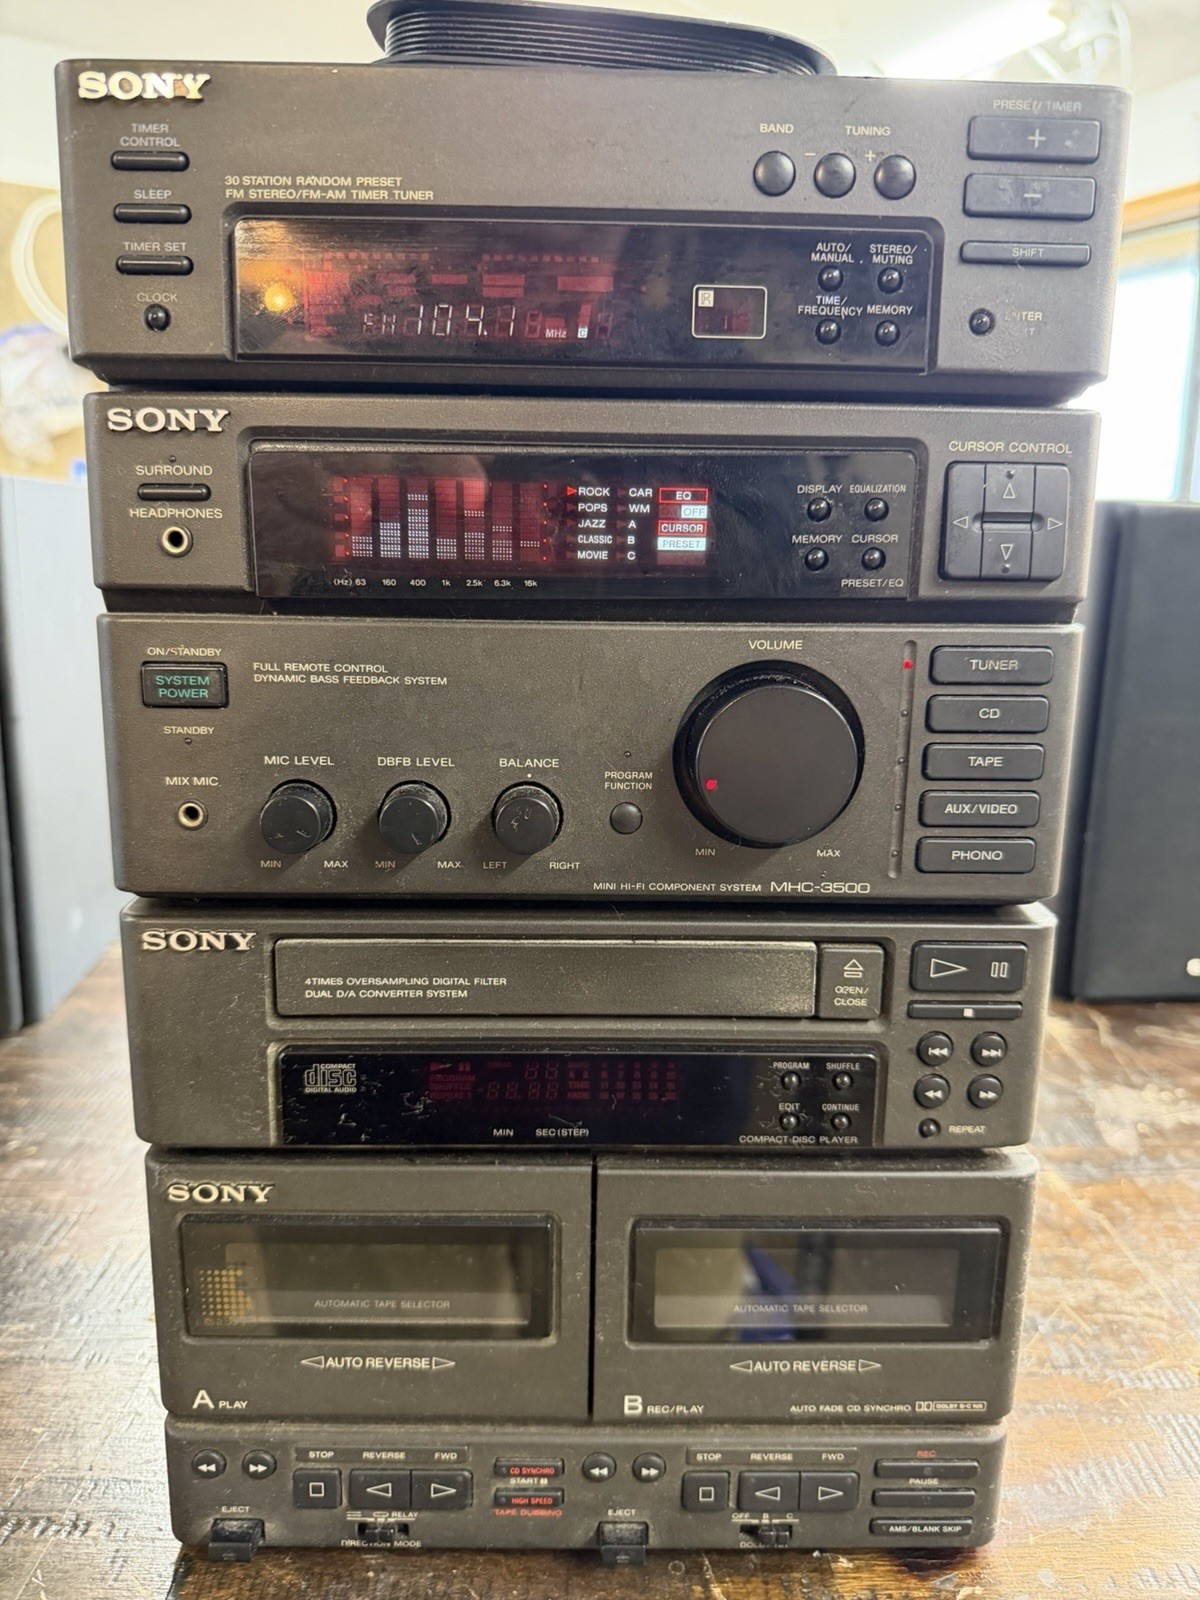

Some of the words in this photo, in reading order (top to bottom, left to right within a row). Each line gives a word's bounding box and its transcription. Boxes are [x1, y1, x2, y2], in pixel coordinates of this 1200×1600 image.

[78, 71, 211, 100] SONY
[131, 123, 169, 133] TIMER
[759, 123, 794, 134] BAND
[845, 126, 891, 137] TUNING
[120, 137, 180, 147] CONTROL
[224, 175, 240, 186] 30
[242, 176, 292, 186] STATION
[296, 176, 352, 186] RANDOM
[356, 177, 402, 187] PRESET
[134, 190, 172, 199] SLEEP
[226, 189, 244, 199] FM
[249, 189, 346, 200] STEREO/FM-AM
[352, 190, 391, 200] TIMER
[393, 190, 434, 200] TUNER
[123, 242, 161, 252] TIMER
[164, 242, 188, 252] SET
[816, 242, 851, 253] AUTO/
[869, 244, 918, 255] STEREO/
[1012, 247, 1044, 258] SHIFT
[811, 253, 855, 263] MANUAL
[872, 255, 913, 265] MUTING
[137, 293, 178, 302] CLOCK
[816, 295, 848, 306] TIME/
[798, 306, 863, 317] FREQUENCY
[867, 305, 913, 315] MEMORY
[546, 329, 567, 338] MHz
[107, 408, 230, 432] SONY
[949, 442, 1004, 452] CURSOR
[1009, 442, 1073, 454] CONTROL
[135, 465, 213, 476] SURROUND
[578, 487, 610, 497] ROCK
[628, 488, 652, 497] CAR
[797, 485, 842, 494] DISPLAY
[850, 485, 906, 494] EQUALIZATION
[676, 491, 692, 500] EQ
[578, 503, 608, 512] POPS
[629, 504, 650, 513] WM
[130, 508, 223, 519] HEADPHONES
[578, 519, 606, 528] JAZZ
[628, 520, 636, 529] A
[661, 524, 703, 532] CURSOR
[578, 535, 612, 544] CLASSIC
[628, 536, 635, 544] B
[792, 535, 842, 544] MEMORY
[851, 534, 898, 543] CURSOR
[578, 551, 608, 560] MOVIE
[627, 552, 636, 560] C
[333, 579, 352, 587] (Hz)
[382, 579, 396, 587] 160
[410, 579, 426, 587] 400
[442, 579, 451, 587] 1k
[841, 578, 904, 588] PRESET/EQ
[748, 640, 803, 650] VOLUME
[147, 647, 222, 657] ON/STANDBY
[253, 662, 281, 672] FULL
[284, 663, 330, 673] REMOTE
[334, 663, 388, 673] CONTROL
[970, 660, 1018, 671] TUNER
[155, 675, 210, 686] SYSTEM
[254, 674, 307, 683] DYNAMIC
[310, 675, 339, 684] BASS
[343, 675, 400, 685] FEEDBACK
[404, 676, 447, 685] SYSTEM
[158, 688, 209, 698] POWER
[979, 708, 1000, 719] CD
[164, 726, 214, 734] STANDBY
[264, 756, 290, 765] MIC
[294, 756, 335, 766] LEVEL
[378, 757, 412, 767] DBFB
[416, 757, 455, 767] LEVEL
[499, 758, 560, 768] BALANCE
[968, 756, 1003, 767] TAPE
[166, 776, 190, 786] MIX
[193, 776, 219, 786] MIC
[604, 772, 652, 780] PROGRAM
[604, 782, 652, 790] FUNCTION
[944, 804, 1018, 814] AUX/VIDEO
[695, 848, 716, 856] MIN
[816, 849, 840, 858] MAX
[952, 850, 1003, 860] PHONO
[260, 860, 282, 869] MIN
[324, 860, 349, 869] MAX
[374, 860, 396, 869] MIN
[437, 860, 462, 869] MAX
[482, 861, 507, 870] LEFT
[550, 862, 580, 870] RIGHT
[593, 882, 616, 890] MINI
[648, 883, 716, 892] COMPONENT
[719, 883, 761, 892] SYSTEM
[770, 881, 870, 893] MHC-3500
[142, 930, 256, 952] SONY
[433, 978, 471, 986] DIGITAL
[474, 978, 507, 986] FILTER
[305, 990, 333, 998] DUAL
[336, 990, 356, 998] D/A
[359, 990, 423, 998] CONVERTER
[427, 990, 467, 998] SYSTEM
[834, 986, 869, 995] OPEN/
[834, 998, 867, 1006] CLOSE
[773, 1062, 810, 1070] PROGRAM
[826, 1062, 860, 1070] SHUFFLE
[778, 1103, 800, 1111] EDIT
[822, 1103, 859, 1112] CONTINUE
[949, 1125, 986, 1134] REPEAT
[739, 1135, 789, 1144] COMPACT
[792, 1135, 816, 1144] DISC
[819, 1136, 858, 1144] PLAYER
[166, 1182, 274, 1204] SONY
[314, 1299, 371, 1309] AUTOMATIC
[374, 1299, 398, 1309] TAPE
[400, 1299, 451, 1310] SELECTOR
[733, 1304, 789, 1313] AUTOMATIC
[792, 1304, 816, 1313] TAPE
[818, 1304, 869, 1313] SELECTOR
[326, 1356, 363, 1369] AUTO
[366, 1357, 431, 1370] REVERSE
[754, 1361, 791, 1372] AUTO
[793, 1361, 856, 1372] REVERSE
[192, 1389, 215, 1410] A
[219, 1400, 248, 1410] PLAY
[624, 1395, 643, 1414] B
[647, 1405, 704, 1414] REC/PLAY
[434, 1452, 458, 1460] FWD
[697, 1453, 722, 1461] STOP
[750, 1453, 793, 1461] REVERSE
[822, 1453, 844, 1461] FWD
[889, 1525, 940, 1533] AMS/BLANK
